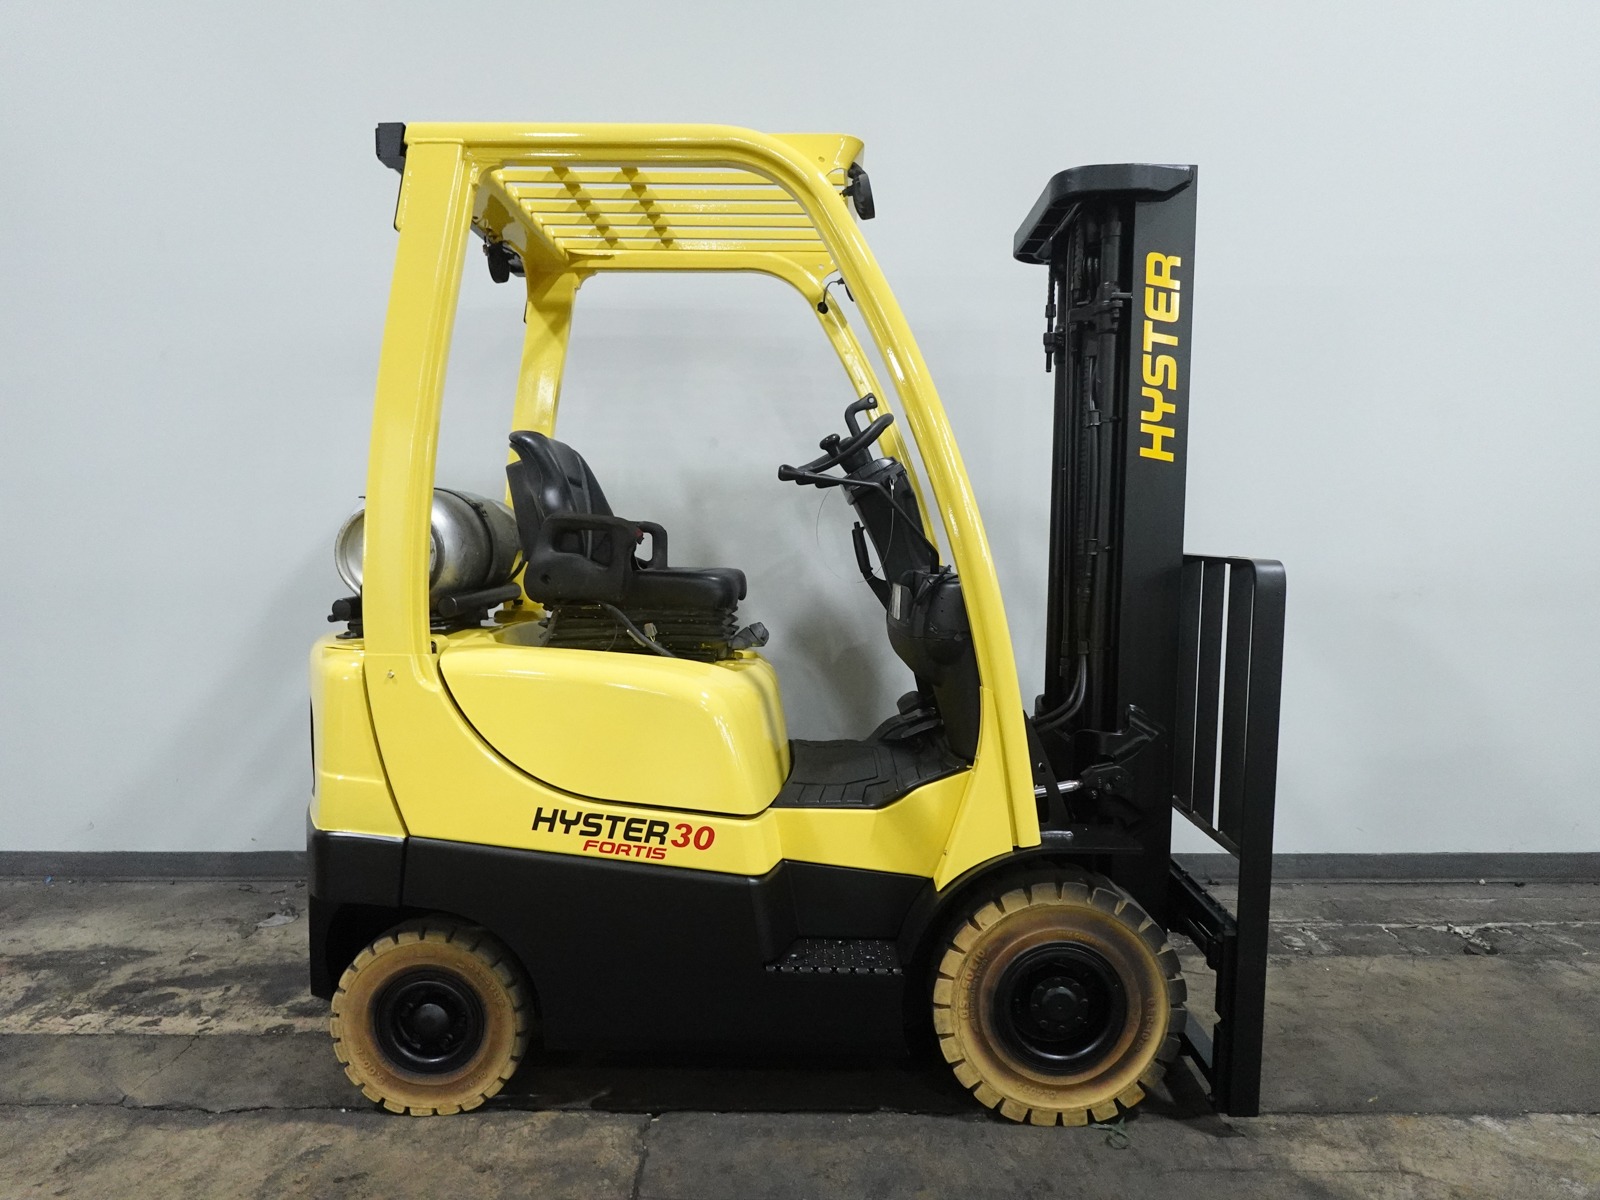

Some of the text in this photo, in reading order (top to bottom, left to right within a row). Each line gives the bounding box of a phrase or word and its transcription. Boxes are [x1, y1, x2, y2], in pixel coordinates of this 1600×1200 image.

[1139, 252, 1182, 463] HYSTER
[531, 806, 715, 851] HYSTER 30
[583, 840, 667, 860] FORTIS
